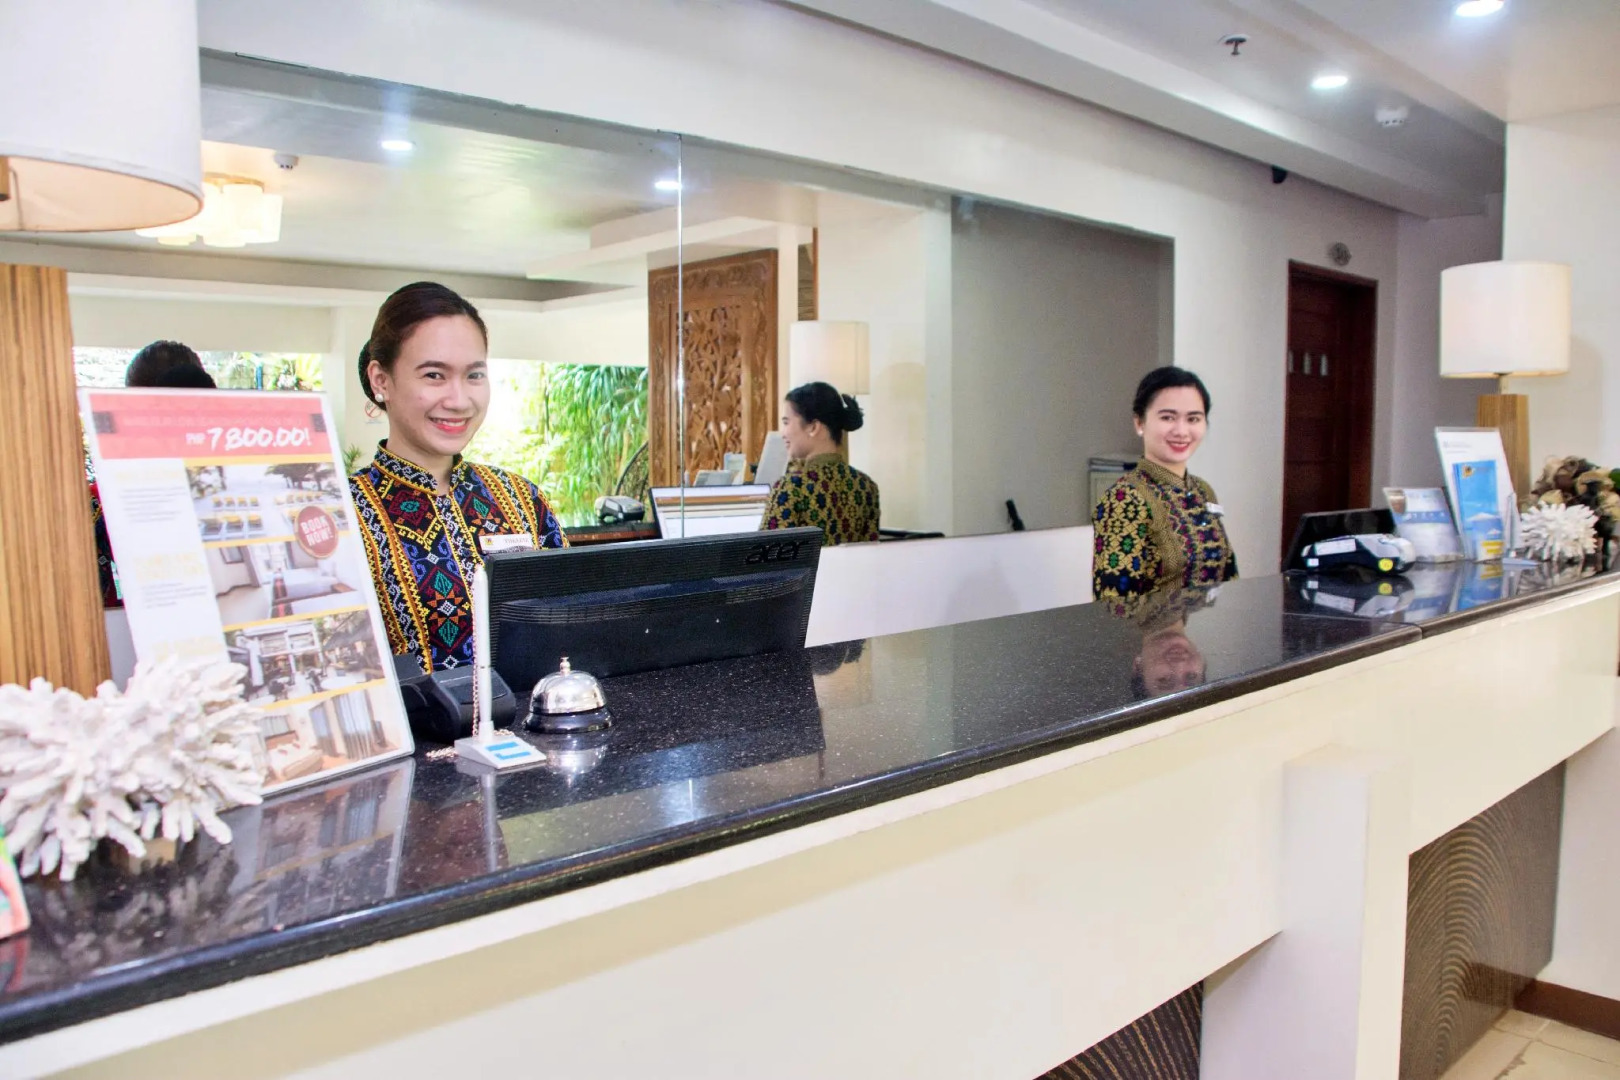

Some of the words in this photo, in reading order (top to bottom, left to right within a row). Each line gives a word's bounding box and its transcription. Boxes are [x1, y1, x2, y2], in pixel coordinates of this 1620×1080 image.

[301, 516, 330, 535] BOOK
[306, 528, 334, 546] NOW!
[744, 540, 809, 564] acer
